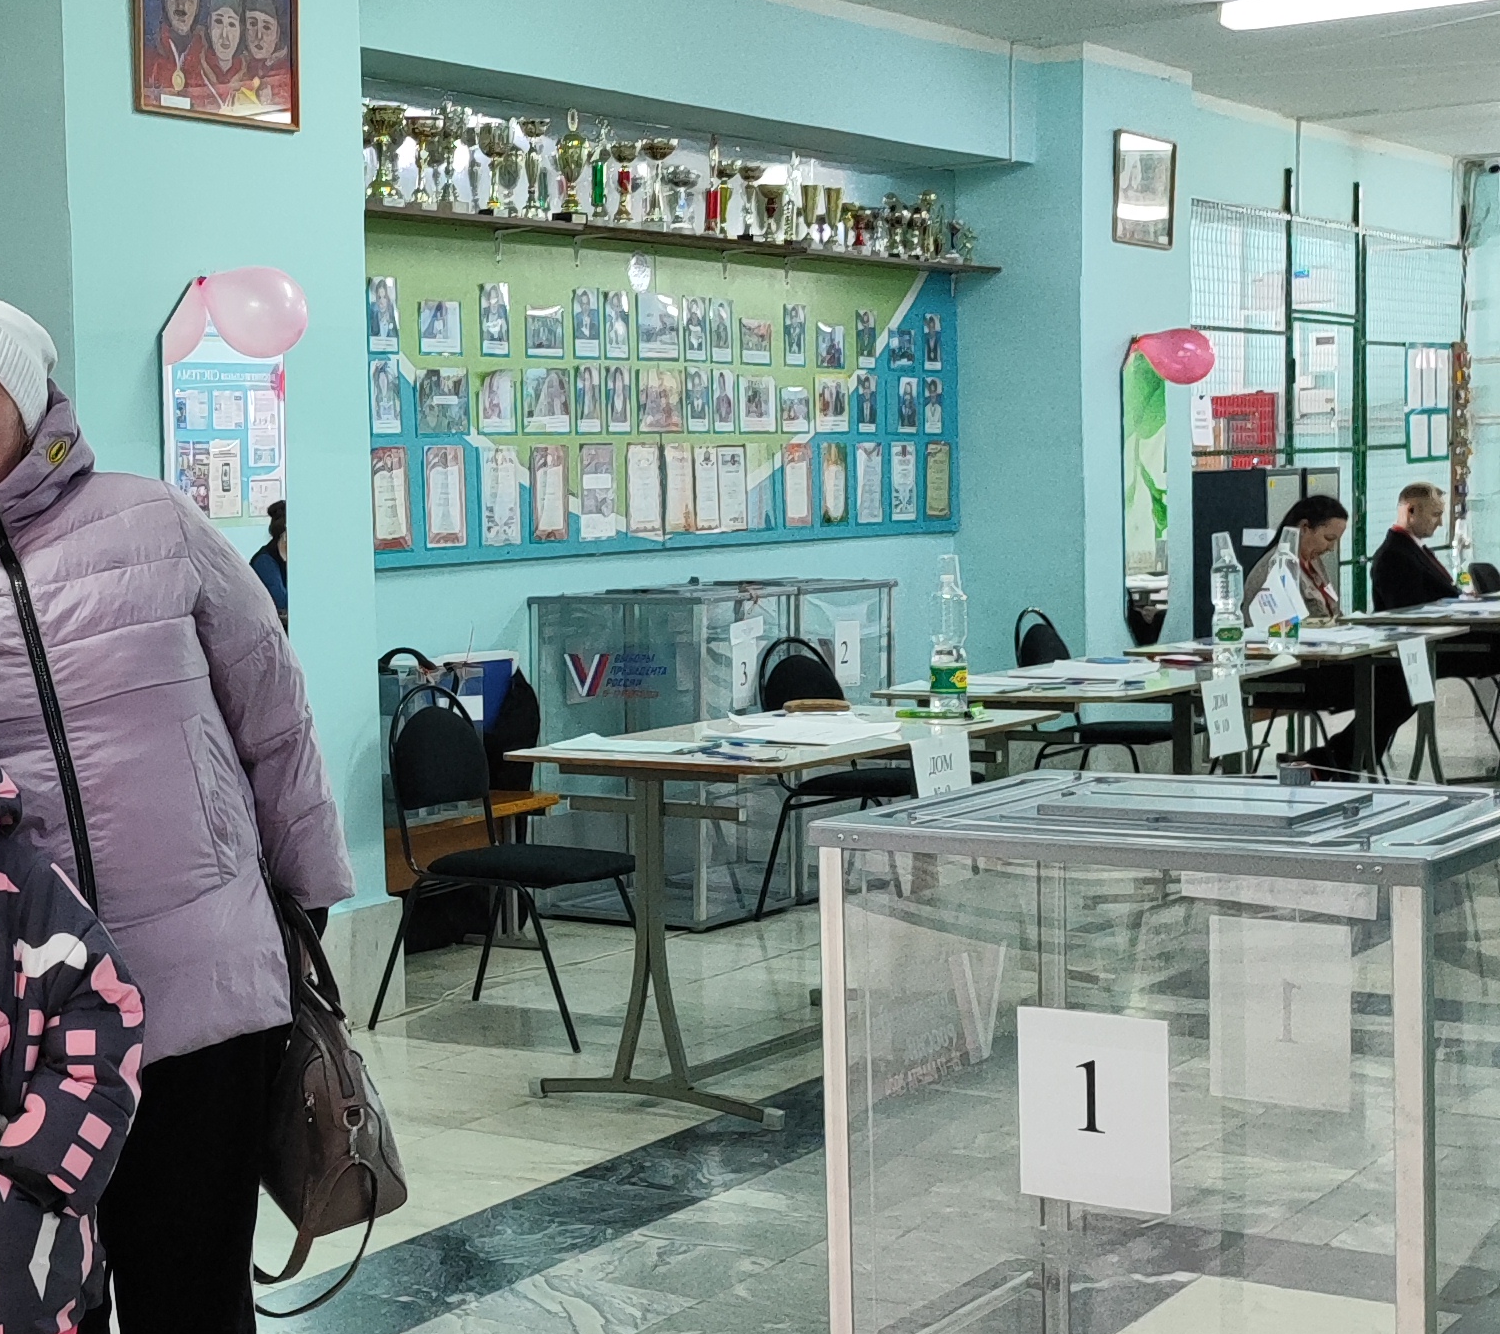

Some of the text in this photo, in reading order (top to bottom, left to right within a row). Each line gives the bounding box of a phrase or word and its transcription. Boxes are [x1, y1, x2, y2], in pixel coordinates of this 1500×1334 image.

[840, 640, 849, 665] 2
[740, 661, 748, 687] 3
[928, 752, 954, 777] ДОМ
[1075, 1059, 1106, 1135] 1
